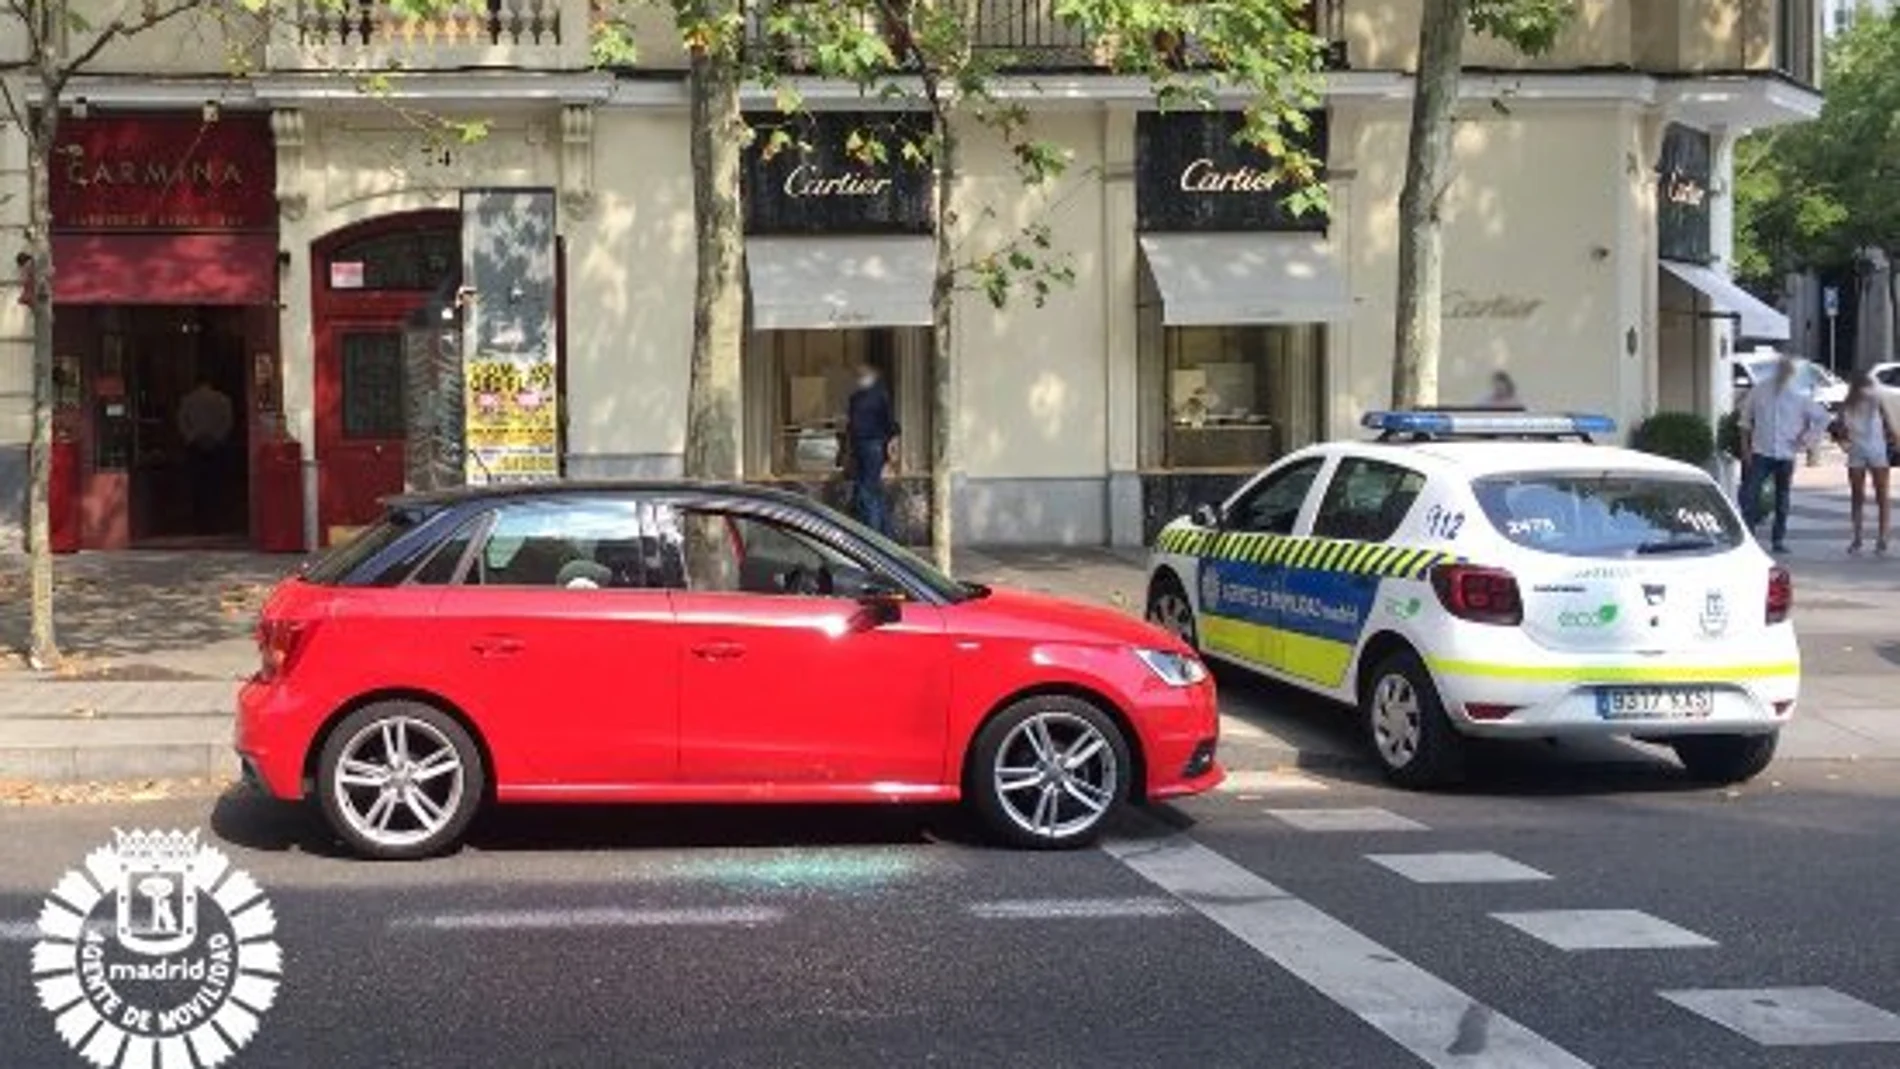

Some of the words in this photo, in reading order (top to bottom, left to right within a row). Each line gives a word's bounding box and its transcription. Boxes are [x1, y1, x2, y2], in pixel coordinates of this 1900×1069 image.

[68, 161, 243, 187] CARMINA
[784, 165, 892, 197] Cartier
[1430, 510, 1465, 540] 112
